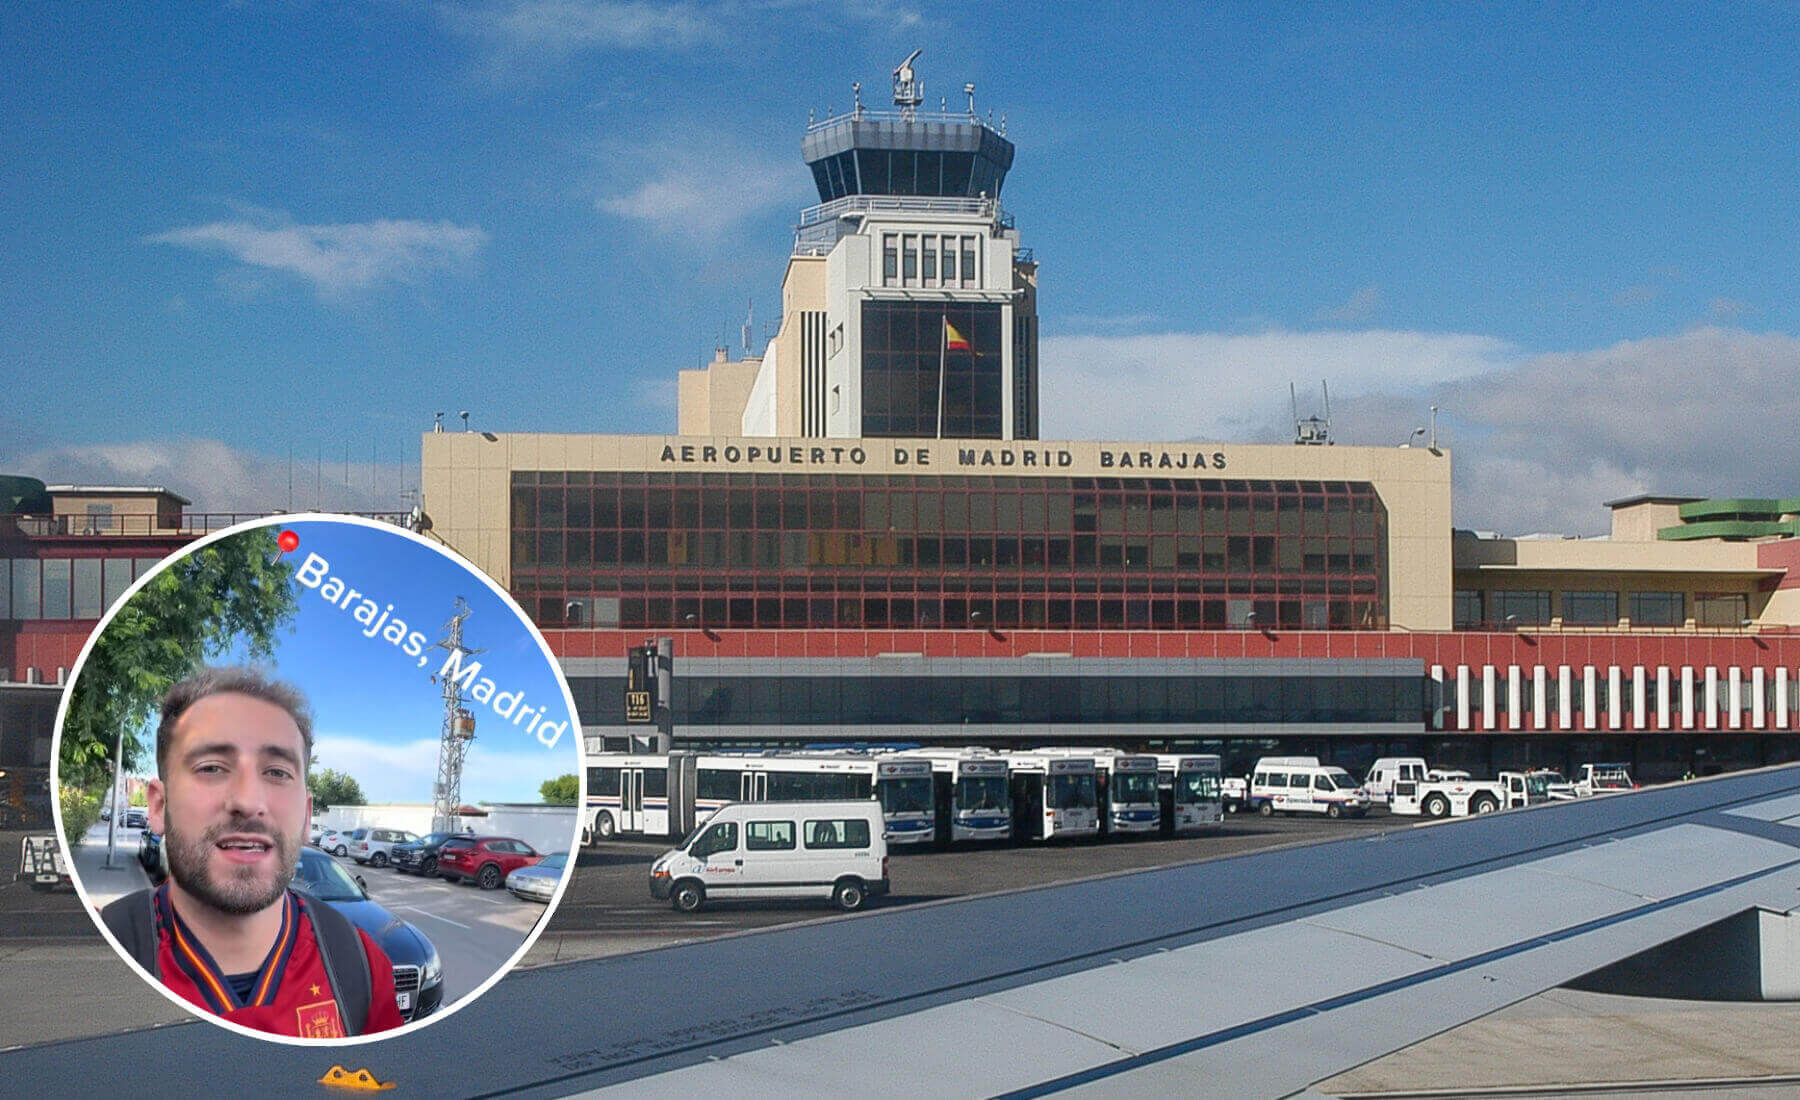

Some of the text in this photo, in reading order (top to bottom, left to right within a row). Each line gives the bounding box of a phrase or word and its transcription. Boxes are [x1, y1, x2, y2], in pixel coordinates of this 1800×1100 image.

[661, 446, 1227, 470] AEROPUERTO DE MADRID BARAJAS
